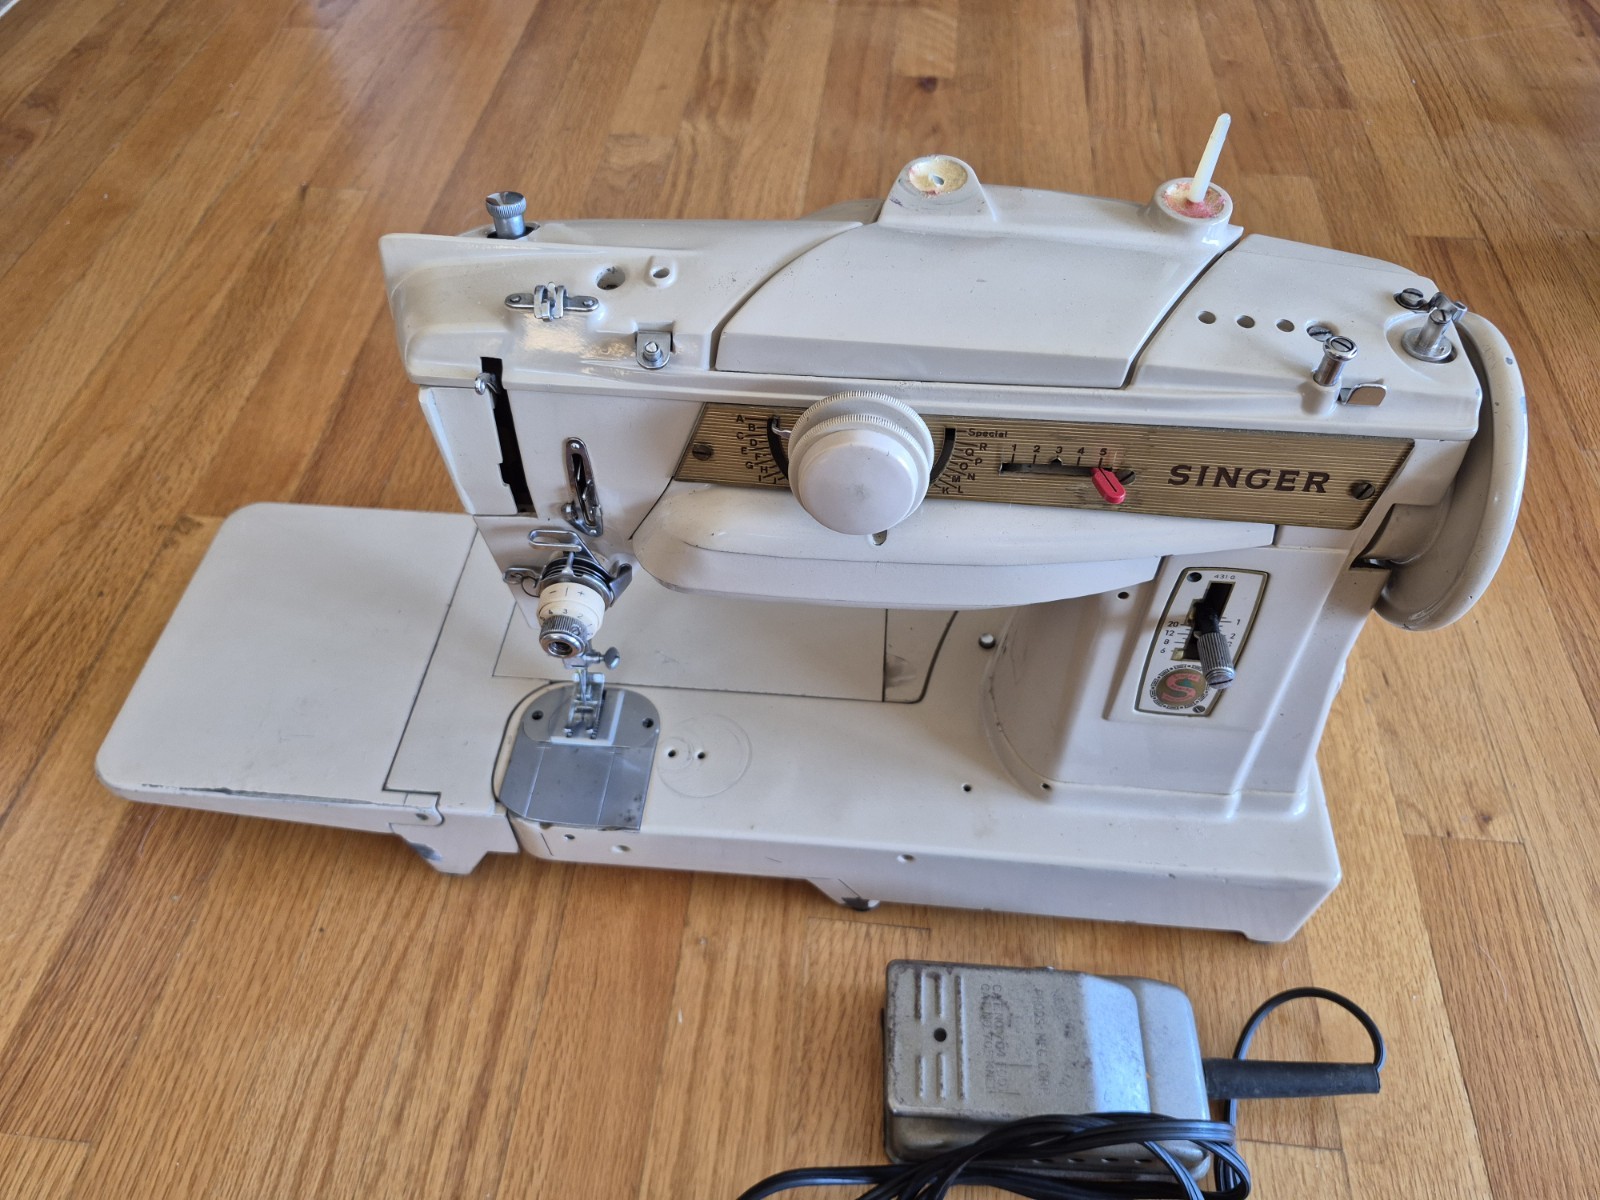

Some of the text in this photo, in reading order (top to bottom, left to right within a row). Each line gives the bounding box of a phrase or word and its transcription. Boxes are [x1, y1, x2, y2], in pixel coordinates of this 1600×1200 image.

[736, 414, 745, 423] A
[748, 423, 756, 432] B
[736, 432, 745, 440] C
[967, 428, 1008, 438] Special
[750, 439, 758, 447] D
[979, 442, 988, 451] R
[741, 446, 748, 455] E
[965, 448, 975, 457] Q
[1033, 445, 1041, 453] 2
[1055, 446, 1063, 454] 3
[1077, 447, 1085, 455] 4
[1100, 448, 1108, 456] 5
[754, 453, 762, 461] F
[974, 457, 983, 465] P
[745, 461, 754, 470] G
[760, 466, 768, 474] H
[951, 475, 961, 483] M
[967, 473, 976, 481] N
[1167, 464, 1331, 494] SINGER
[942, 486, 950, 494] K
[957, 486, 964, 494] L
[1167, 620, 1179, 628] 20
[1165, 629, 1175, 637] 12
